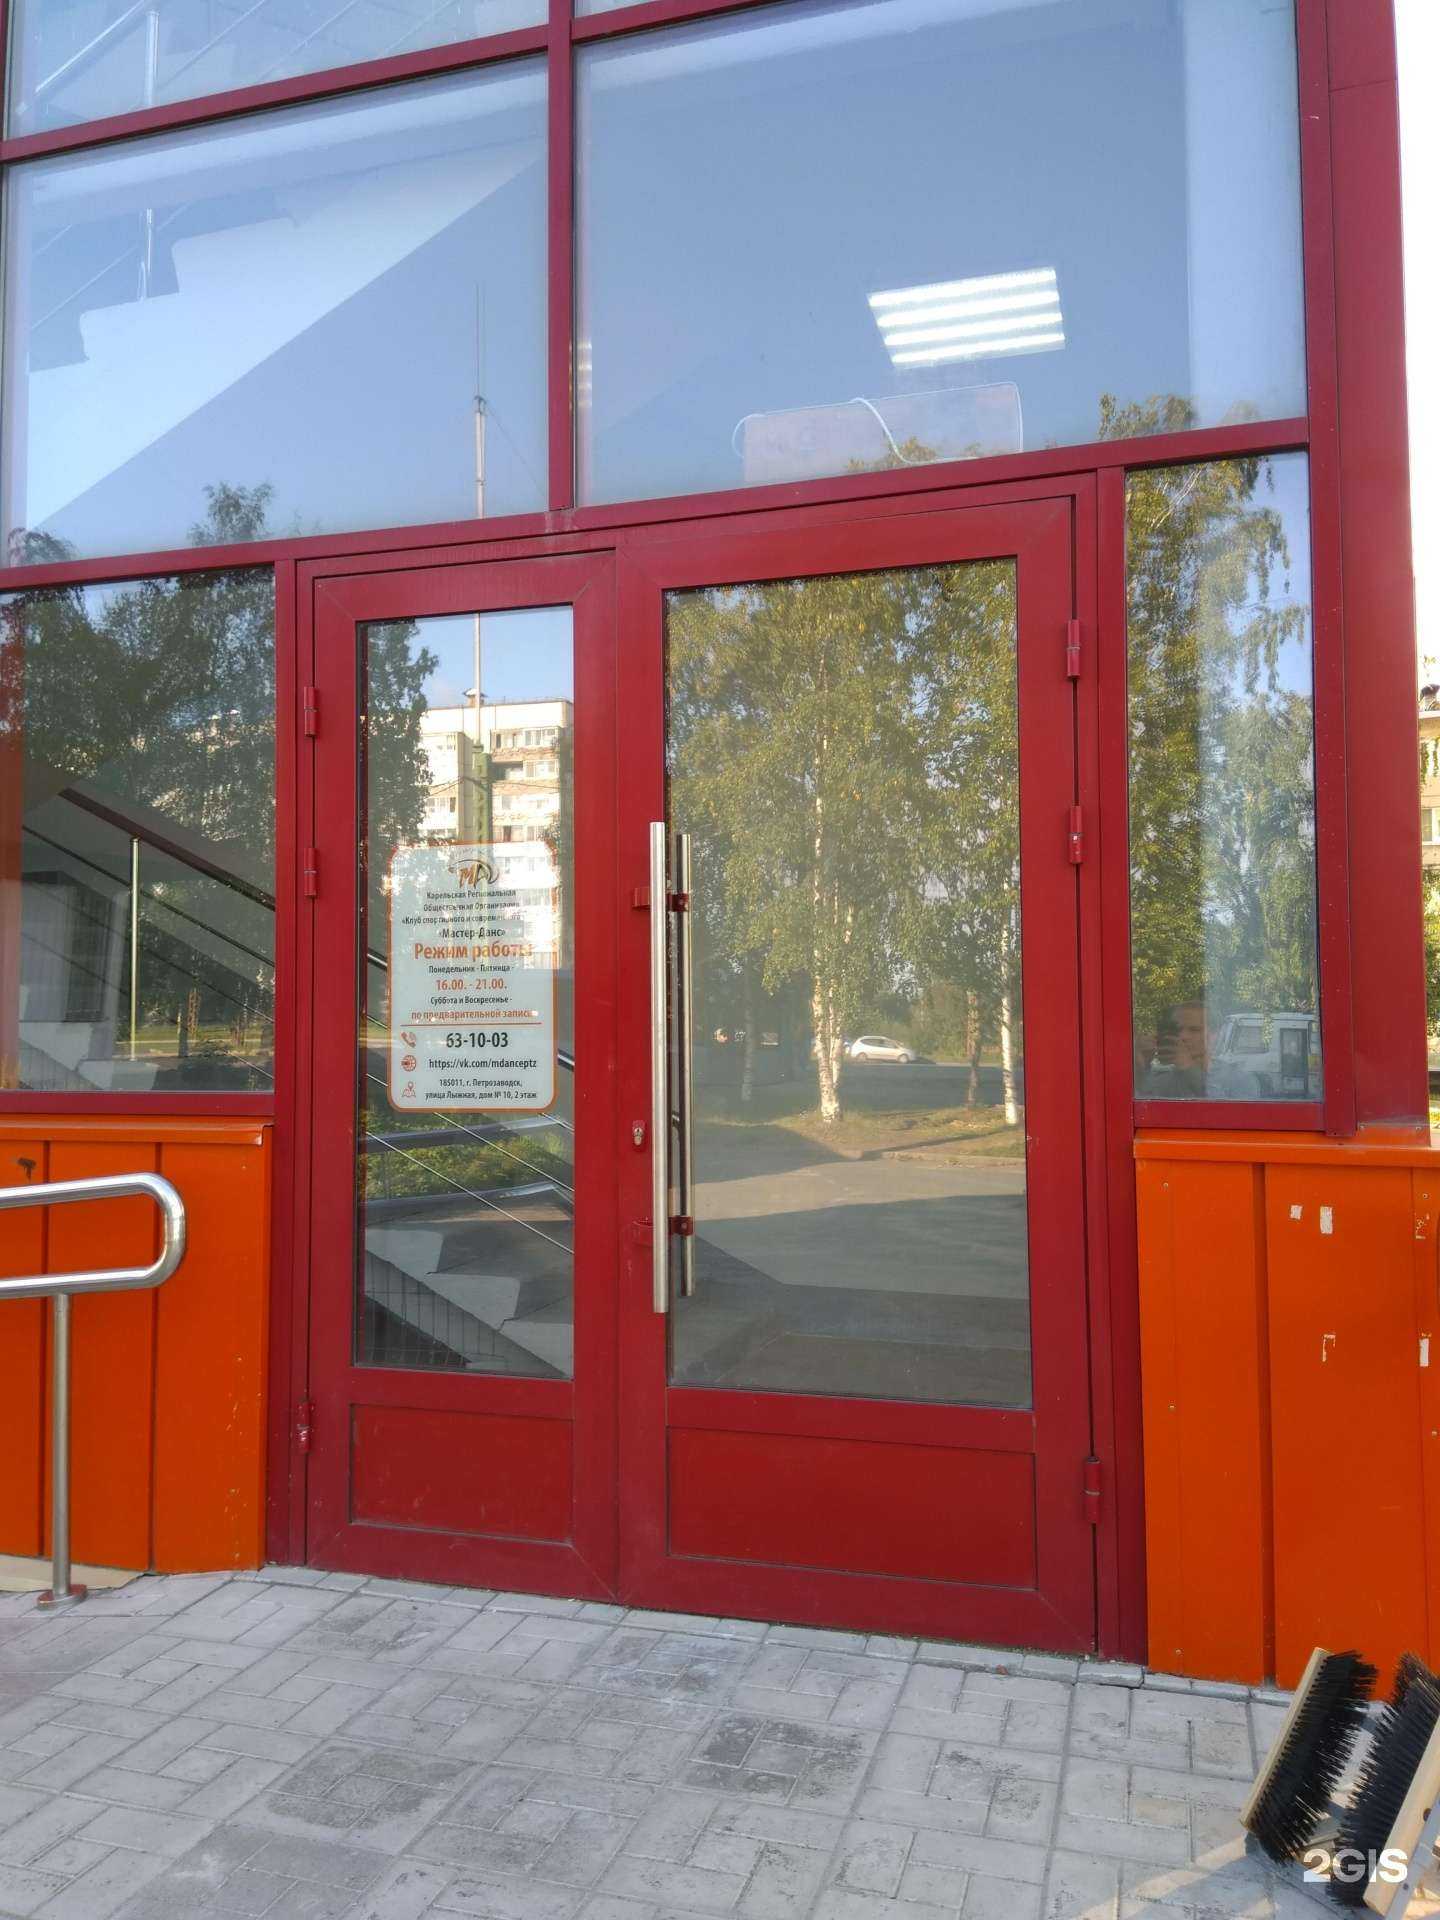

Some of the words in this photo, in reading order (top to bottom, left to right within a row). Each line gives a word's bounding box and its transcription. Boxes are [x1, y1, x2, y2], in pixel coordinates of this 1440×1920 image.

[427, 890, 466, 900] Карельская
[414, 943, 467, 959] Режим
[472, 941, 533, 961] работы
[429, 965, 475, 975] Понедельник
[480, 965, 510, 973] Пятница
[436, 979, 467, 991] 16.00.
[475, 978, 507, 990] 21.00.
[431, 997, 458, 1006] Суббота
[465, 996, 508, 1004] Воскресенье
[411, 1012, 421, 1020] по
[423, 1010, 499, 1021] предварительной
[446, 1032, 508, 1048] 63-10-03
[429, 1059, 537, 1070] https://vk.com/mdanceptz
[439, 1079, 465, 1088] 185011,
[473, 1079, 522, 1088] Петрозаводск,
[425, 1092, 445, 1101] улица
[446, 1091, 477, 1100] Лыжная,
[495, 1091, 501, 1099] №
[503, 1091, 513, 1100] 10,
[514, 1091, 519, 1099] 2
